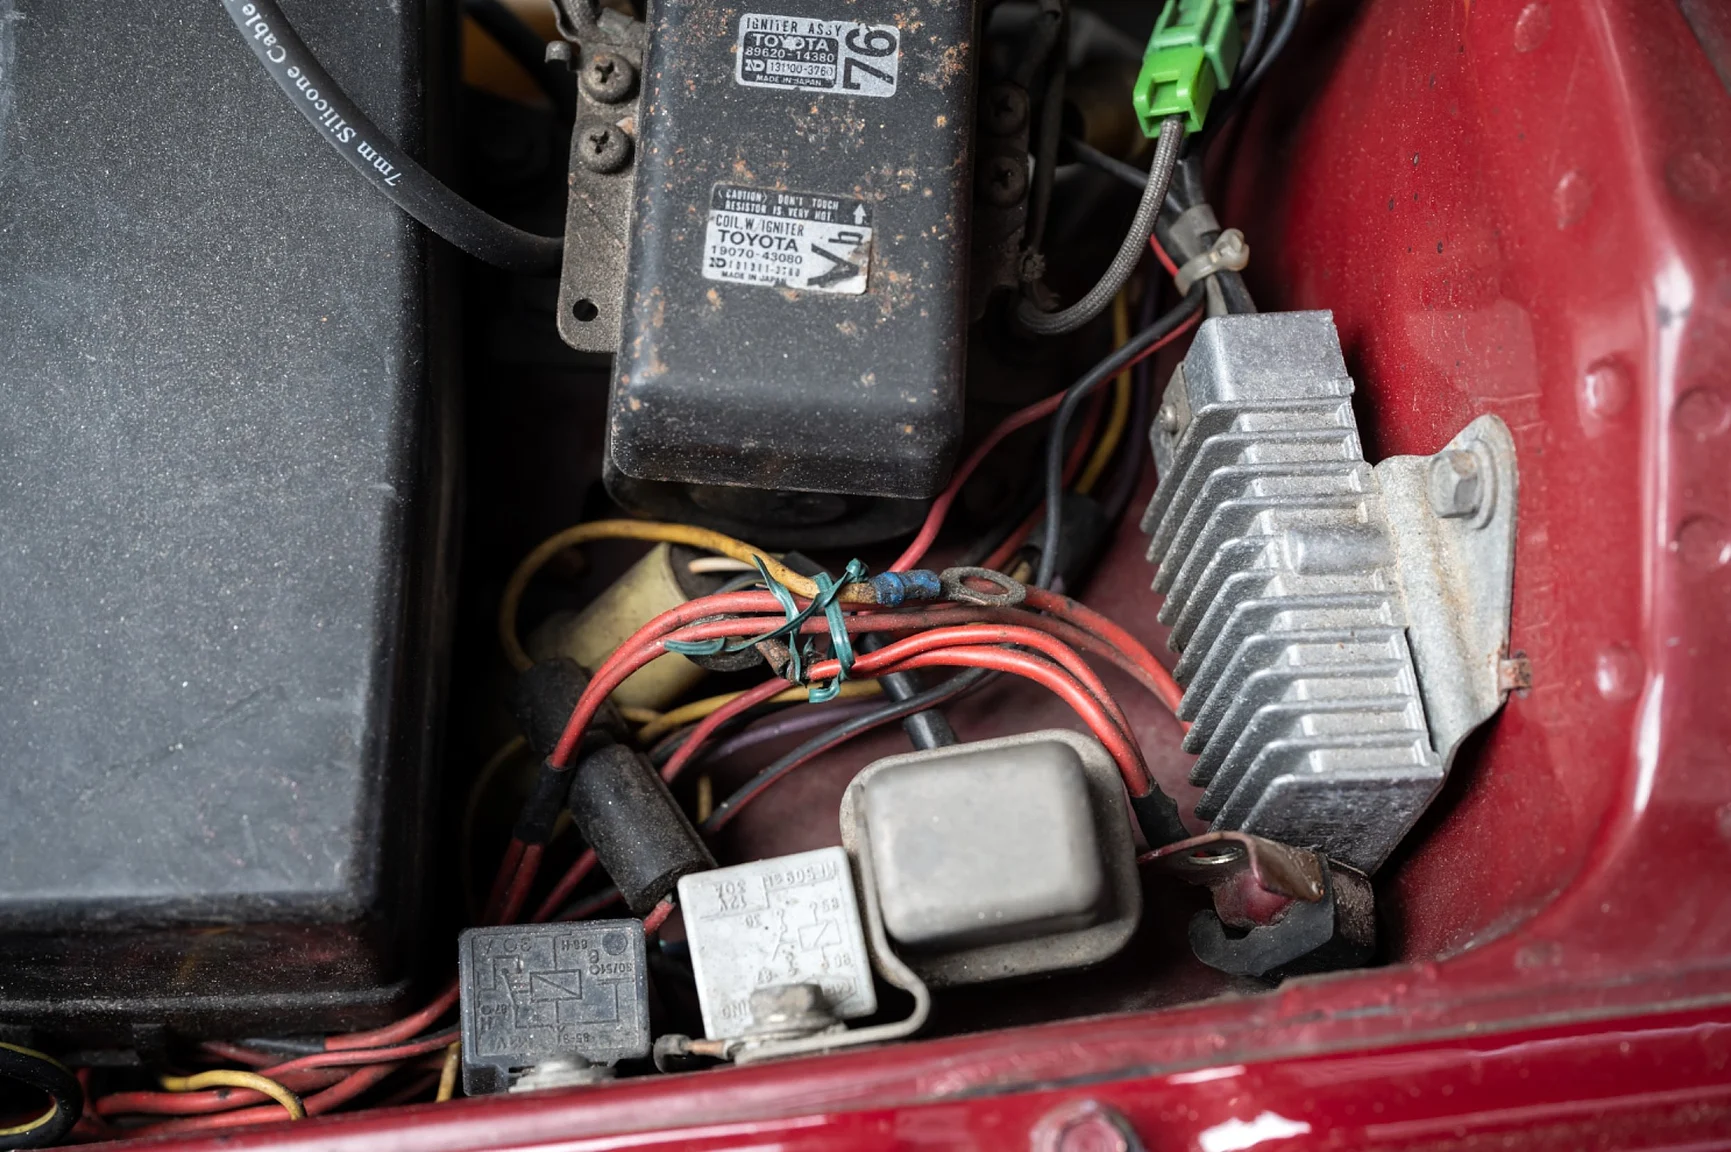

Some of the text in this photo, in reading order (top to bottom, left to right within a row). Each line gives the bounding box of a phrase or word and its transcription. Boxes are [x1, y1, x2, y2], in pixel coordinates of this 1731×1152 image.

[746, 17, 798, 33] IGNITER
[752, 33, 829, 52] TOYOTA
[744, 46, 835, 63] 89620-14380
[842, 27, 897, 90] 76
[241, 2, 402, 186] 7mm Silicone Cable
[724, 200, 767, 214] RESISTOR
[772, 206, 782, 216] IS
[788, 208, 809, 219] VERY
[812, 198, 840, 210] TOUCH
[717, 228, 799, 252] TOYOTA
[711, 245, 804, 265] 19070-43080
[721, 270, 745, 280] MADE
[759, 274, 787, 285] JAPAN
